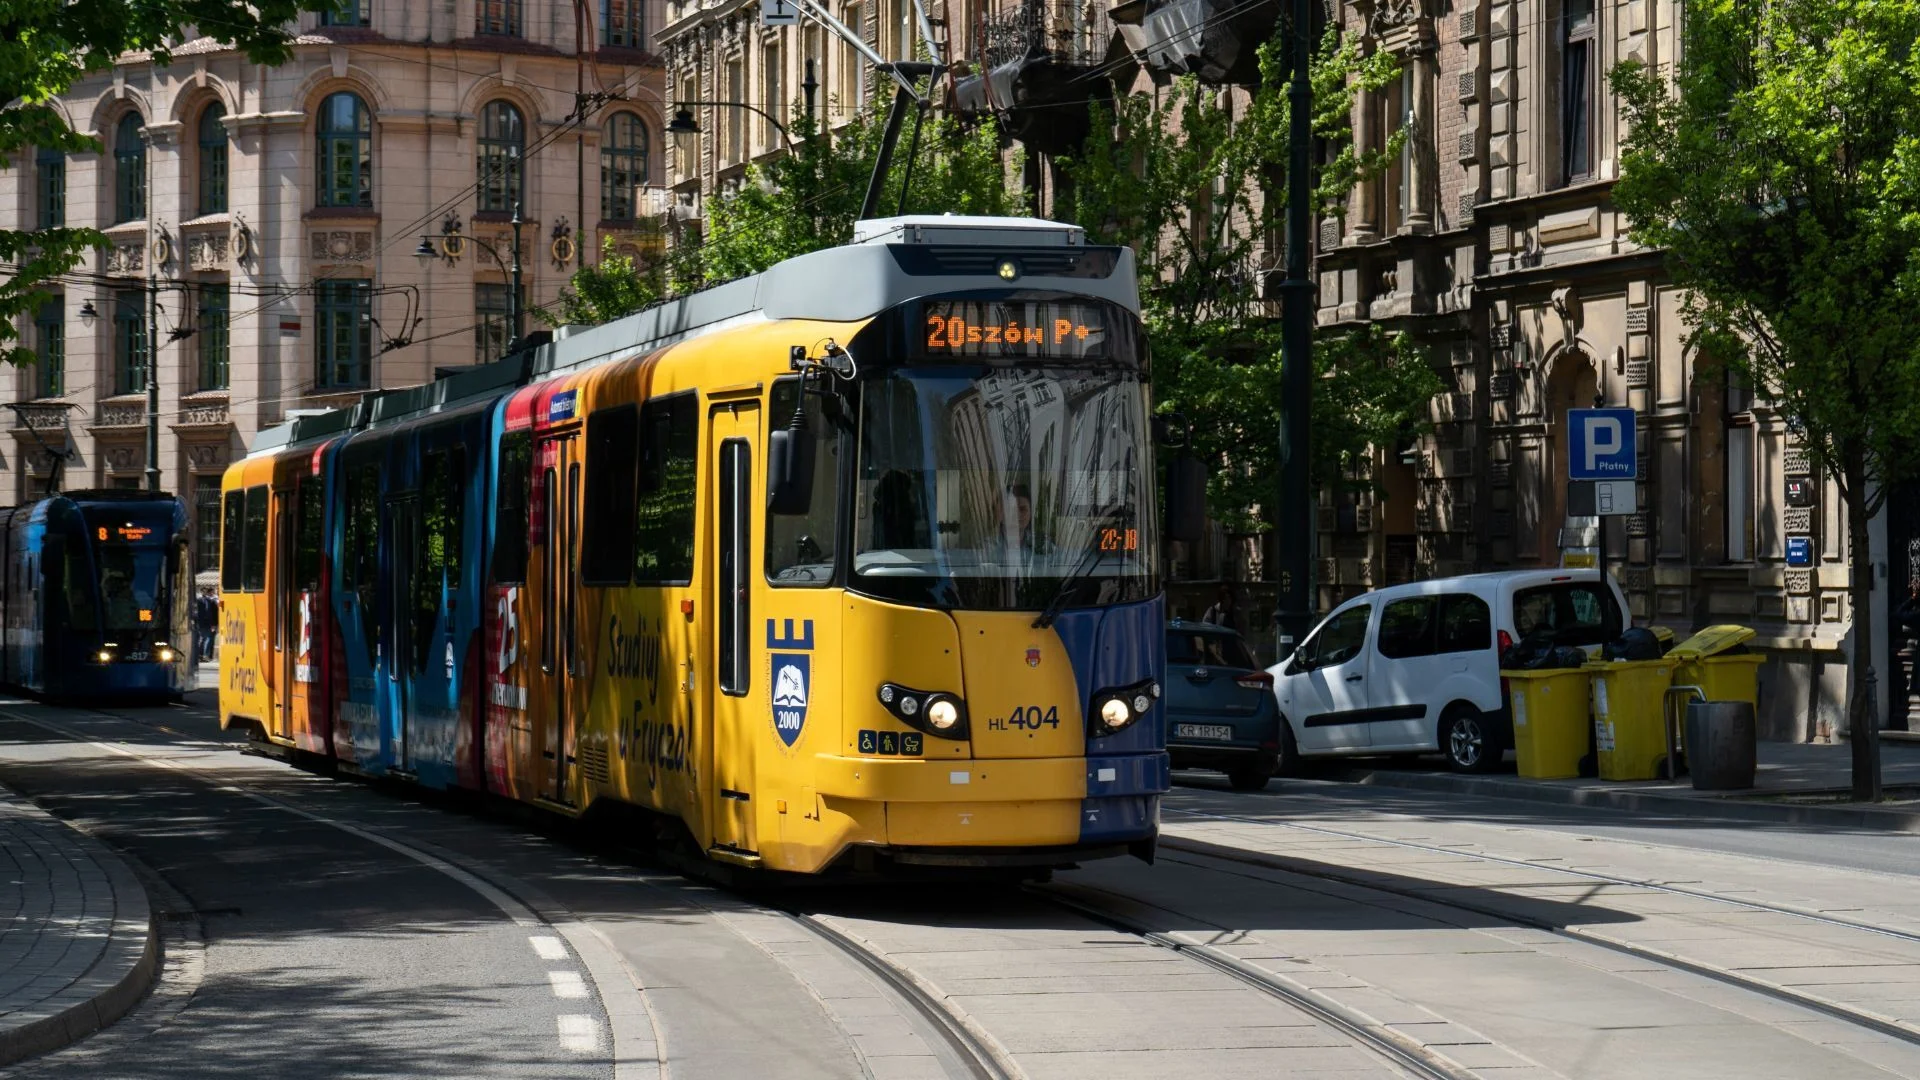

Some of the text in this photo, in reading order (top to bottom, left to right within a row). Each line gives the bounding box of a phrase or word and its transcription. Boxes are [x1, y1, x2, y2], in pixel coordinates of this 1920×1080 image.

[1584, 416, 1622, 471] P
[1599, 461, 1629, 472] Płatny
[98, 527, 108, 540] 8
[497, 586, 518, 675] 25
[608, 611, 661, 706] Studiuj
[778, 710, 800, 730] 2000
[1180, 725, 1195, 737] KR
[633, 698, 693, 790] Frycza!
